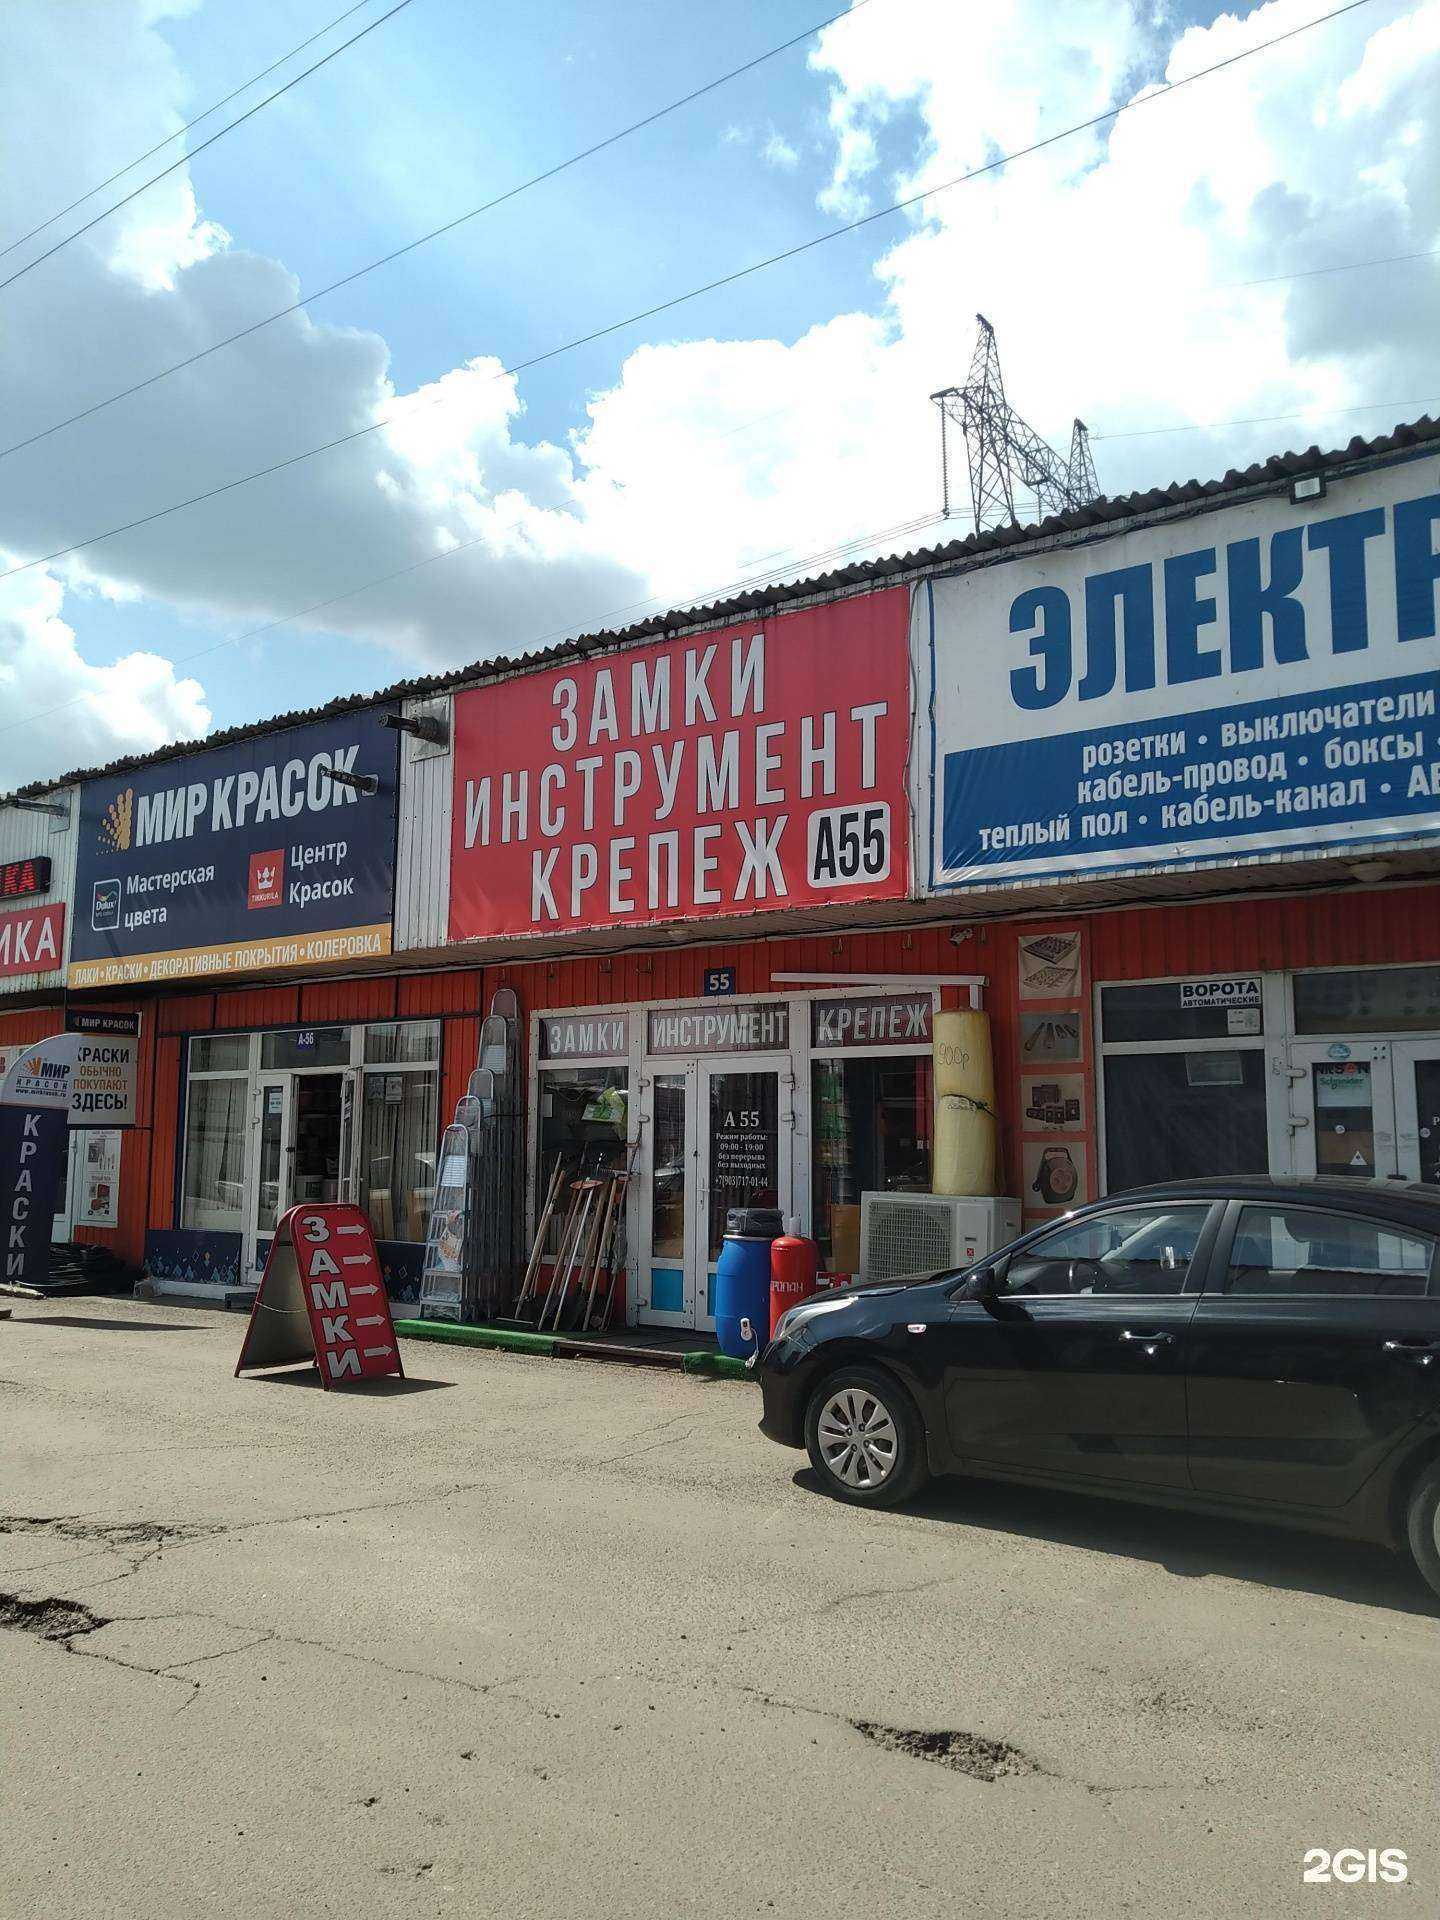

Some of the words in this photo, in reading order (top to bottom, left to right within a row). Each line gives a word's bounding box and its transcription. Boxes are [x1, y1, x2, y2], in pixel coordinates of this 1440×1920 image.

[1009, 493, 1440, 710] ЭЛЕКТР
[551, 633, 766, 752] ЗАМКИ
[1083, 730, 1186, 773] розетки
[1221, 689, 1435, 748] выключатели
[463, 701, 888, 849] ИНСТРУМЕНТ
[1077, 751, 1288, 804] кабель-провод
[1324, 731, 1423, 770] боксы
[136, 782, 208, 847] МИР
[211, 744, 361, 832] КРАСОК
[979, 813, 1070, 850] теплый
[1081, 810, 1128, 838] пол
[1162, 779, 1366, 829] кабель-канал
[291, 841, 347, 871] Центр
[812, 809, 885, 880] А55
[127, 865, 215, 894] Мастерская
[531, 814, 789, 922] КРЕПЕЖ
[289, 877, 354, 908] Красок
[125, 907, 167, 931] цвета
[75, 967, 99, 985] ЛАКИ
[105, 962, 143, 981] КРАСКИ
[150, 951, 233, 979] ДЕКОРАТИВНЫЕ
[234, 944, 298, 969] ПОКРЫТИЯ
[307, 933, 381, 960] КОЛЕРОВКА
[709, 973, 730, 991] 55
[1183, 981, 1259, 998] ВОРОТА
[1182, 995, 1260, 1007] АВТОМАТИЧЕСКИЕ
[81, 1018, 101, 1028] МИР
[103, 1019, 134, 1030] КРАСОК
[551, 1020, 625, 1054] ЗАМКИ
[652, 1010, 788, 1048] ИНСТРУМЕНТ
[819, 1003, 929, 1041] КРЕПЕЖ
[40, 1062, 71, 1079] МИР
[73, 1078, 128, 1091] ПОКУПАЮТ
[80, 1065, 121, 1077] ОБЫЧНО
[71, 1093, 128, 1112] ЗДЕСЬ!
[724, 1111, 736, 1127] А
[740, 1110, 760, 1127] 55
[715, 1132, 739, 1140] Режим
[720, 1143, 739, 1151] 09:00
[6, 1113, 42, 1276] КРАСКИ
[302, 1216, 363, 1379] ЗАМКИ
